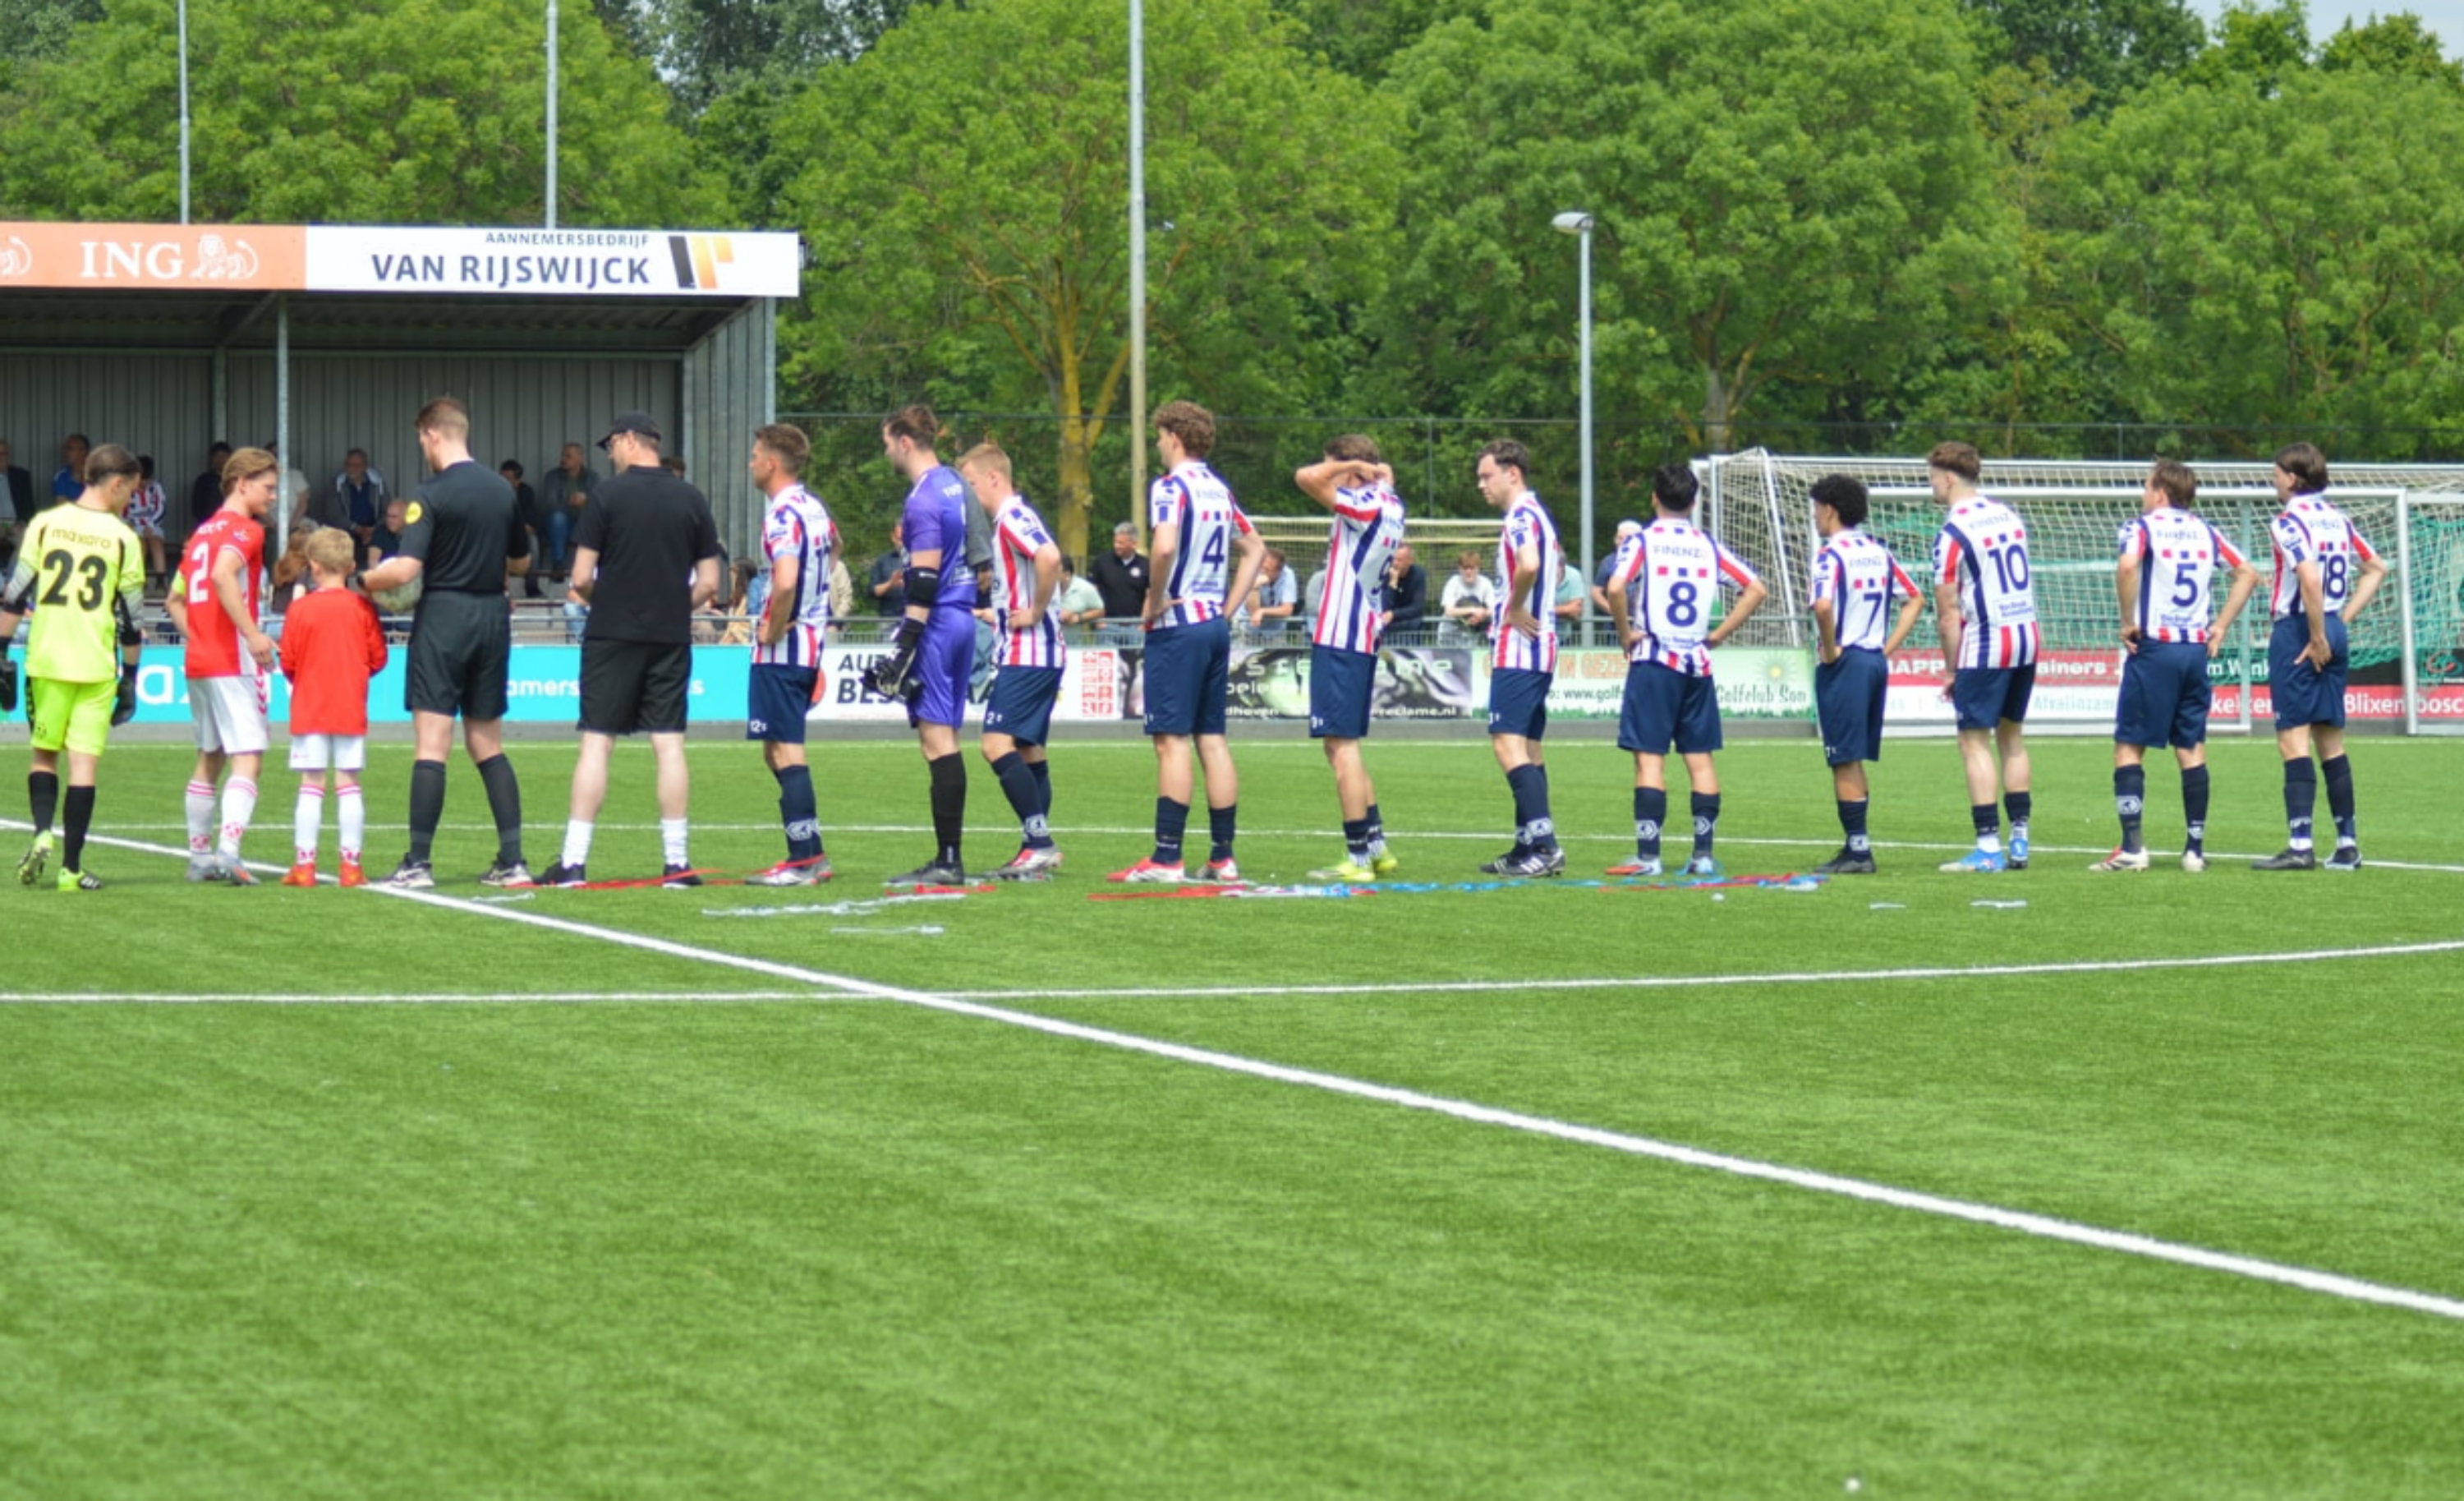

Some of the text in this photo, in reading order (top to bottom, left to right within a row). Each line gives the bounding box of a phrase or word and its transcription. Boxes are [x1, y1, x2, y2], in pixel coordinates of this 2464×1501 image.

[79, 241, 185, 280] ING
[485, 232, 650, 247] AANNEMERSBEDRIJF
[371, 254, 650, 289] VAN RIJSWIJCK
[1202, 524, 1225, 573] 4
[1988, 543, 2029, 595] 10
[39, 549, 108, 612] 23
[189, 541, 209, 604] 2
[2171, 563, 2199, 608] 5
[2318, 554, 2347, 601] 18
[1666, 581, 1698, 628] 8
[1863, 592, 1883, 637] 7
